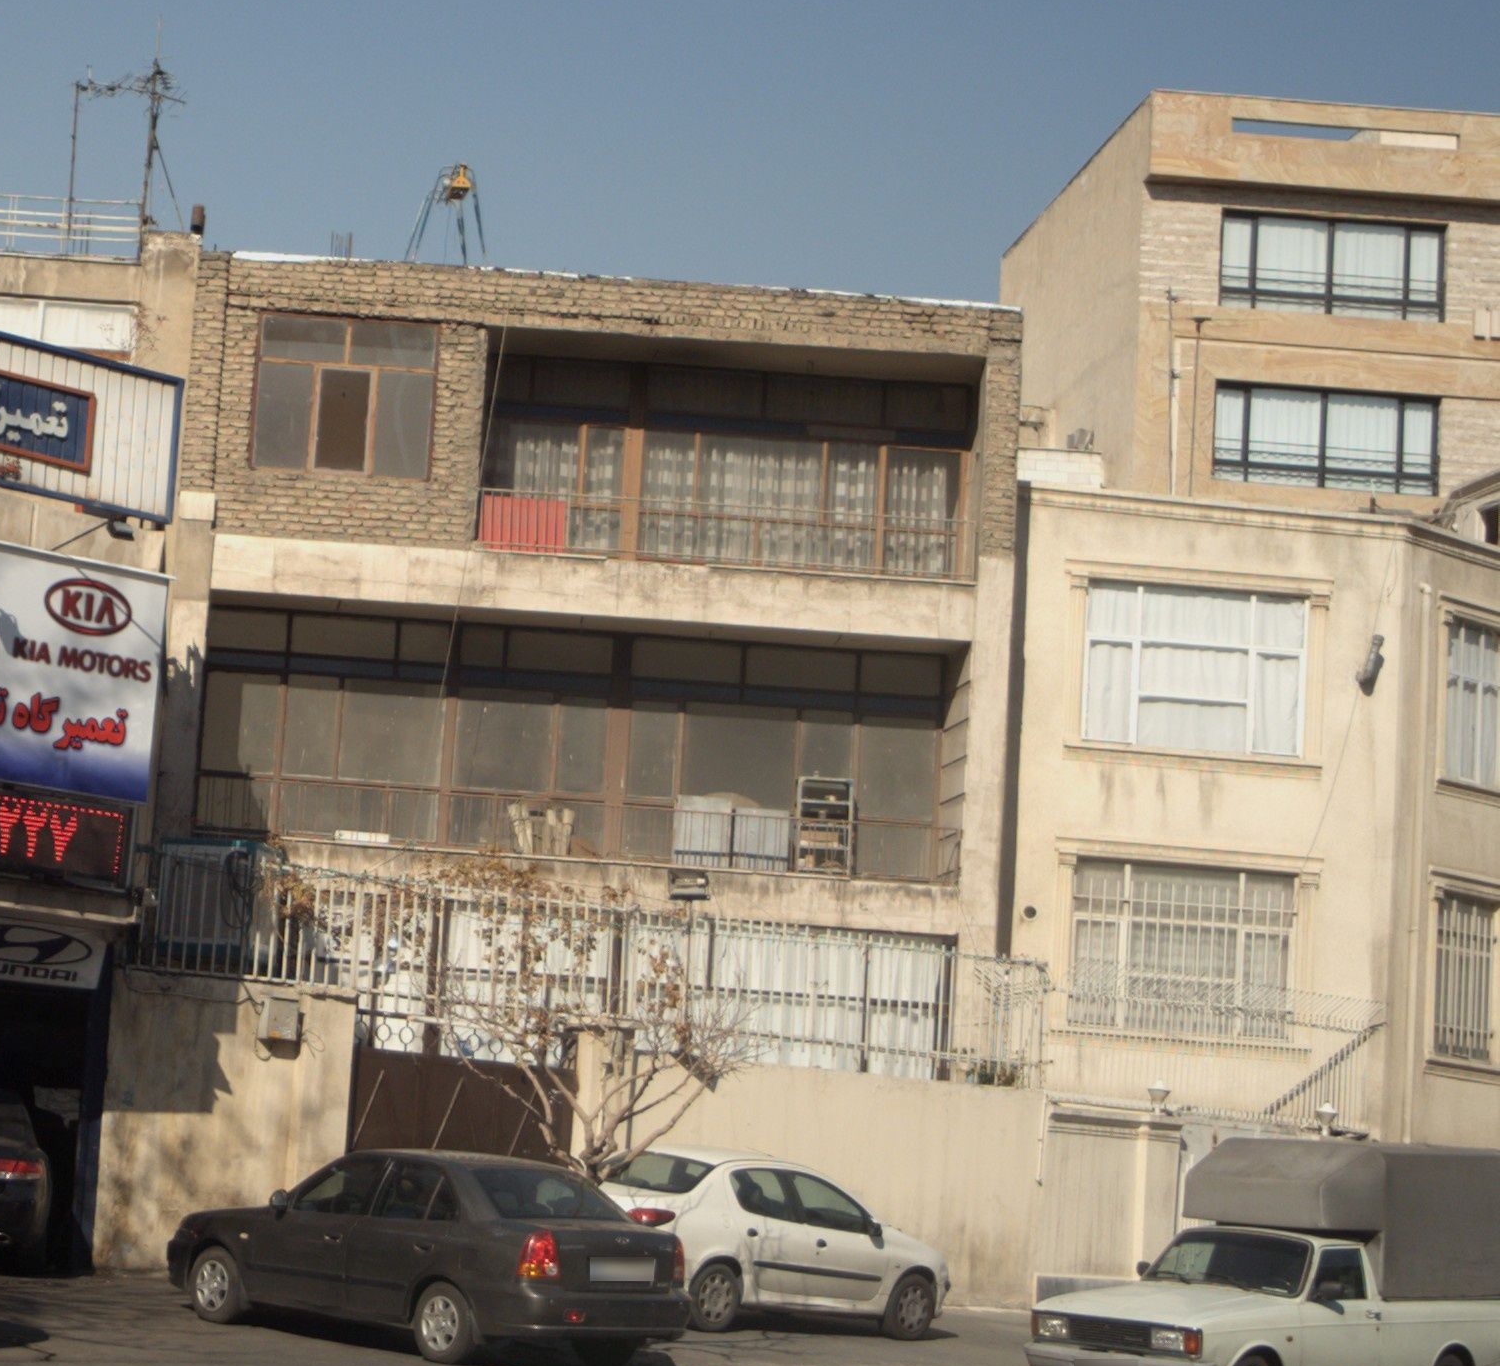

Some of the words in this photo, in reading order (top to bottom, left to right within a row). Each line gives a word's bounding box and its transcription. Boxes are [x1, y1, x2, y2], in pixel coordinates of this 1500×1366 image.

[60, 587, 118, 627] KIA
[12, 636, 52, 665] KIA
[57, 644, 152, 684] MOTORS
